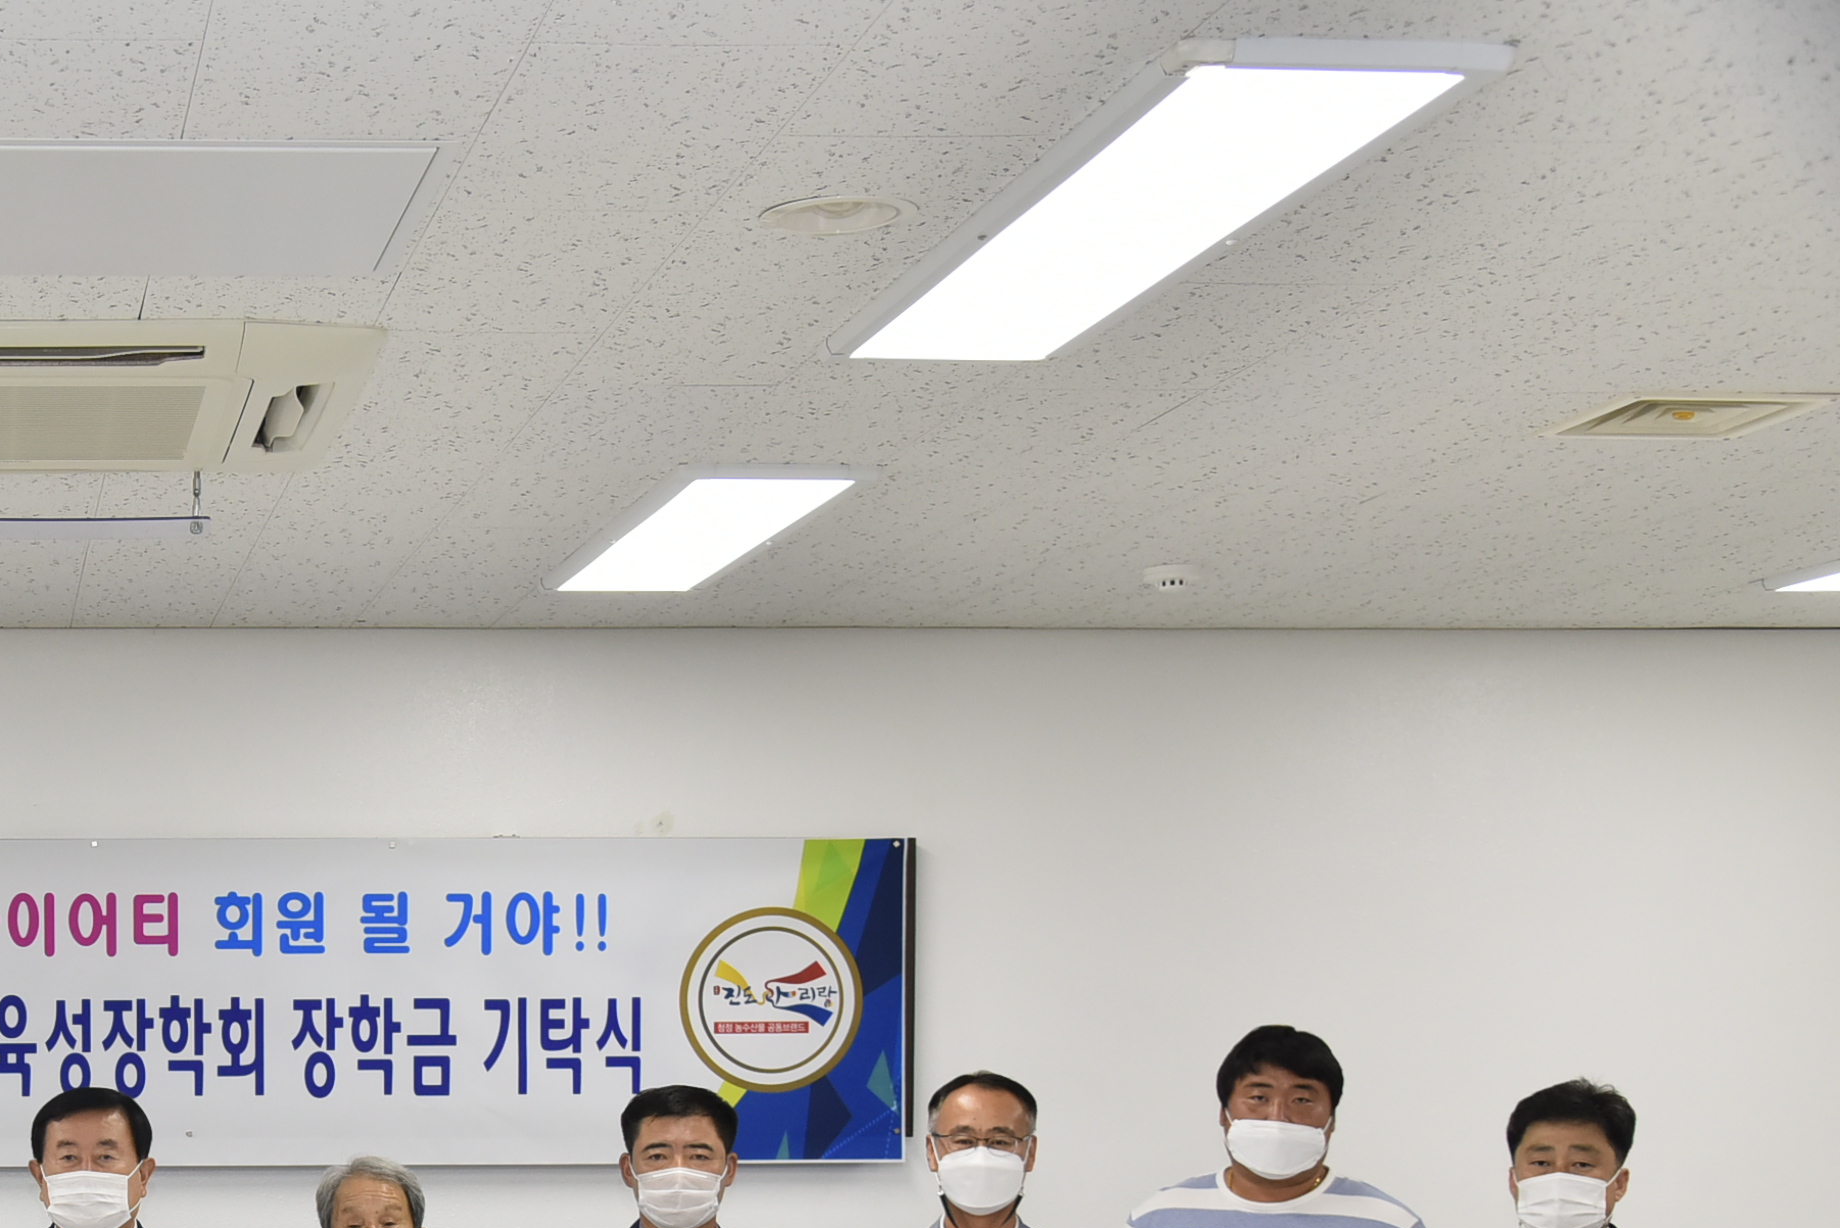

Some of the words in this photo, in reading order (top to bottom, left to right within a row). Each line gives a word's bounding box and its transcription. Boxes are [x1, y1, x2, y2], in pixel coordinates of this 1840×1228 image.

[213, 891, 327, 957] 회원
[359, 891, 411, 957] 될
[443, 891, 608, 957] 거야!!
[291, 993, 459, 1099] 장학금
[483, 993, 644, 1094] 기탁식
